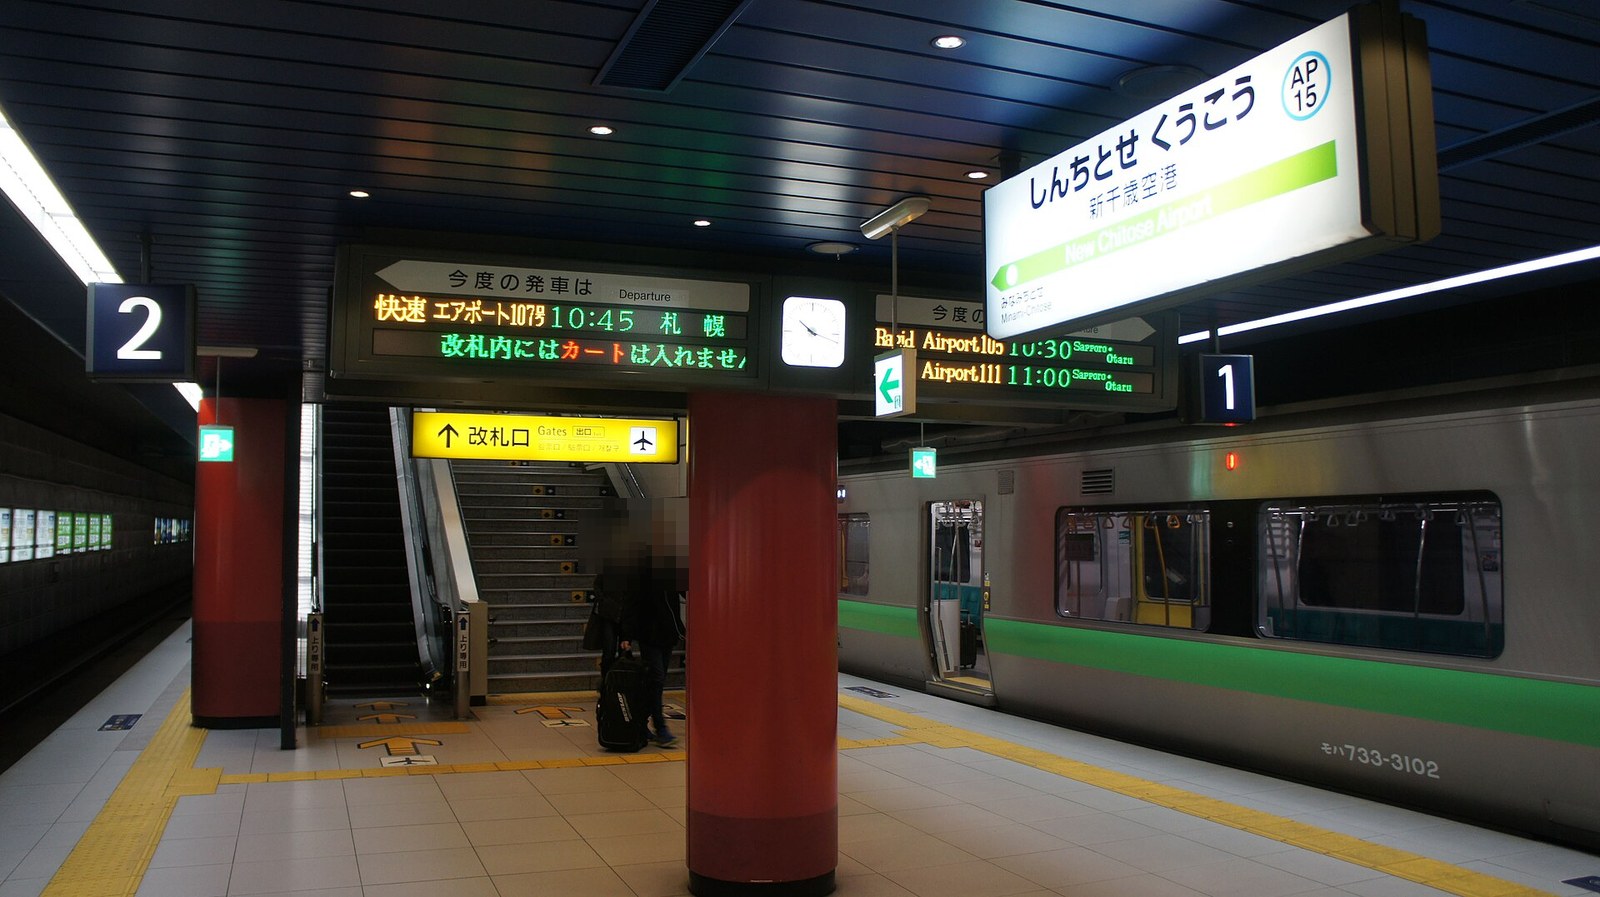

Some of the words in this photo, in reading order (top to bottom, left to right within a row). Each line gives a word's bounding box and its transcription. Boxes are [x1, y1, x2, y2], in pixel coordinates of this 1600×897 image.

[1291, 58, 1318, 89] AP
[1294, 83, 1317, 112] 15
[1031, 129, 1139, 209] しんちとせ
[1152, 75, 1256, 151] くうこう
[1089, 163, 1178, 219] 新千歳空港
[1065, 240, 1095, 265] New
[1098, 219, 1154, 253] Chitose
[1157, 194, 1213, 232] Airport
[449, 269, 593, 296] 今度の発車は
[619, 288, 671, 302] Departure
[374, 294, 427, 323] 快速
[433, 300, 546, 327] エアポート107号
[551, 306, 634, 331] 10:45
[117, 296, 162, 360] 2
[1009, 340, 1072, 359] 10:30
[1106, 353, 1134, 365] Otaru
[1008, 366, 1071, 387] 11:00
[1105, 381, 1133, 392] Otaru
[1218, 364, 1235, 410] 1
[468, 426, 530, 447] 改札口
[537, 425, 567, 437] Gates
[576, 428, 592, 436] 出口
[459, 635, 468, 669] 上り専用
[1321, 742, 1440, 779] モハ733-3102
